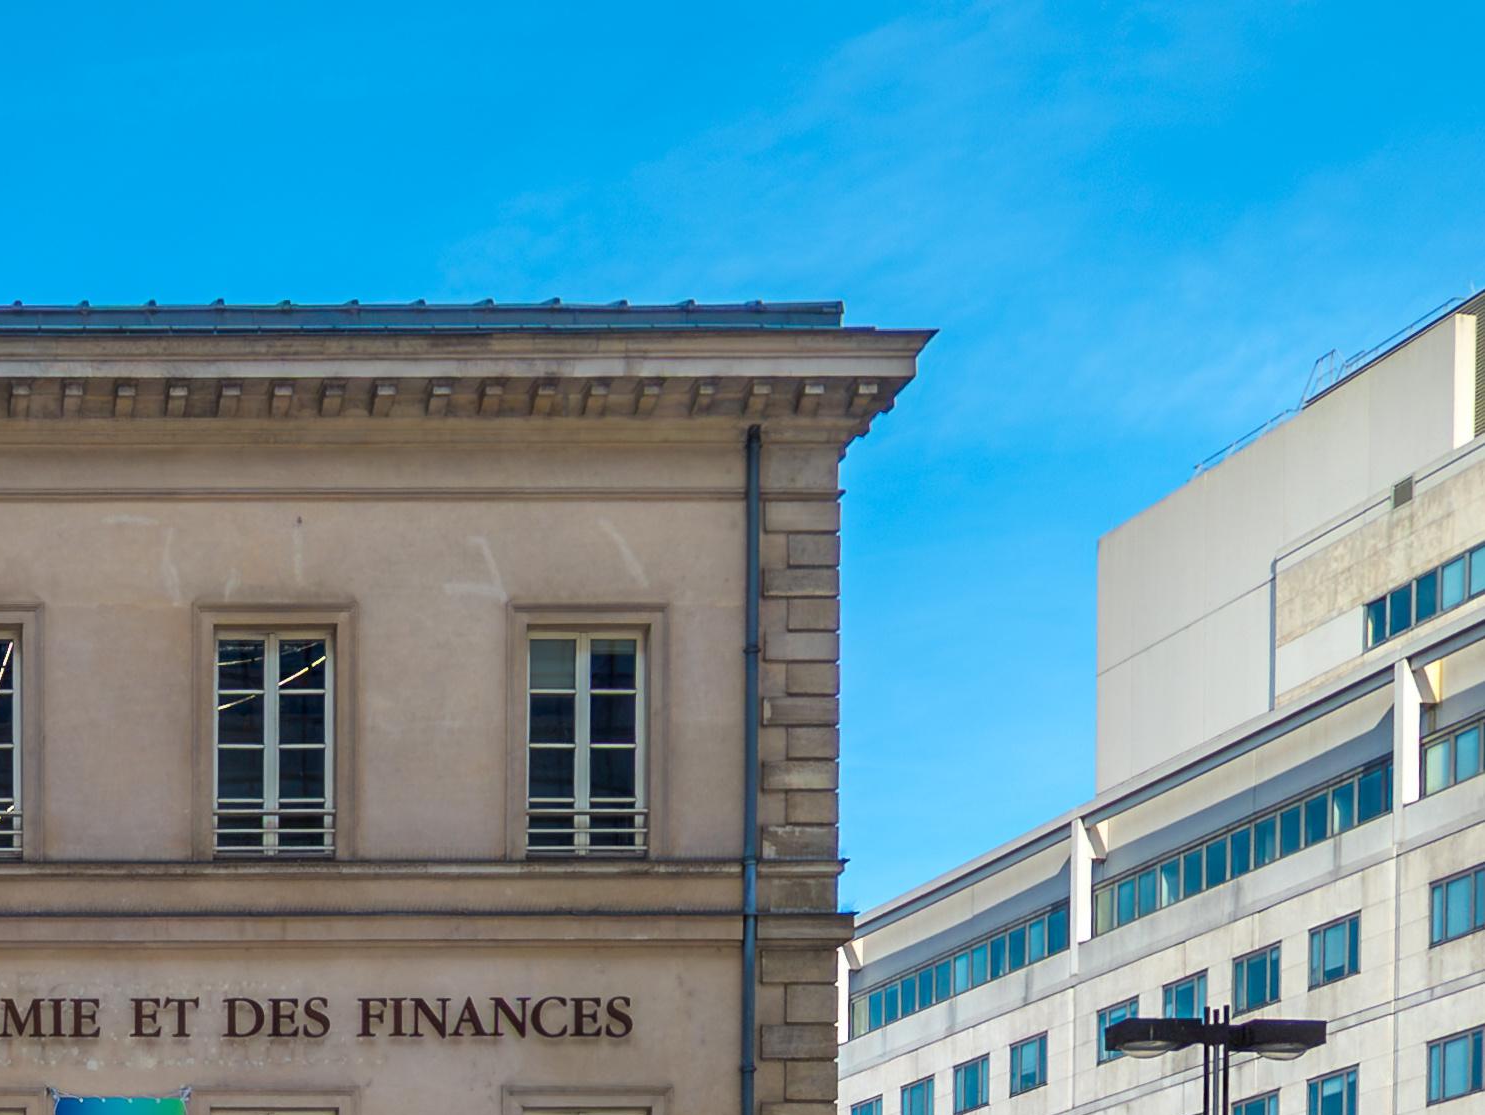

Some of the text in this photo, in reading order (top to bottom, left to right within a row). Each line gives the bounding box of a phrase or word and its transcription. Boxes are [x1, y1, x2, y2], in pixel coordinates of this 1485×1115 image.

[129, 996, 200, 1037] ET
[222, 996, 330, 1038] DES
[357, 996, 633, 1038] FINANCES
